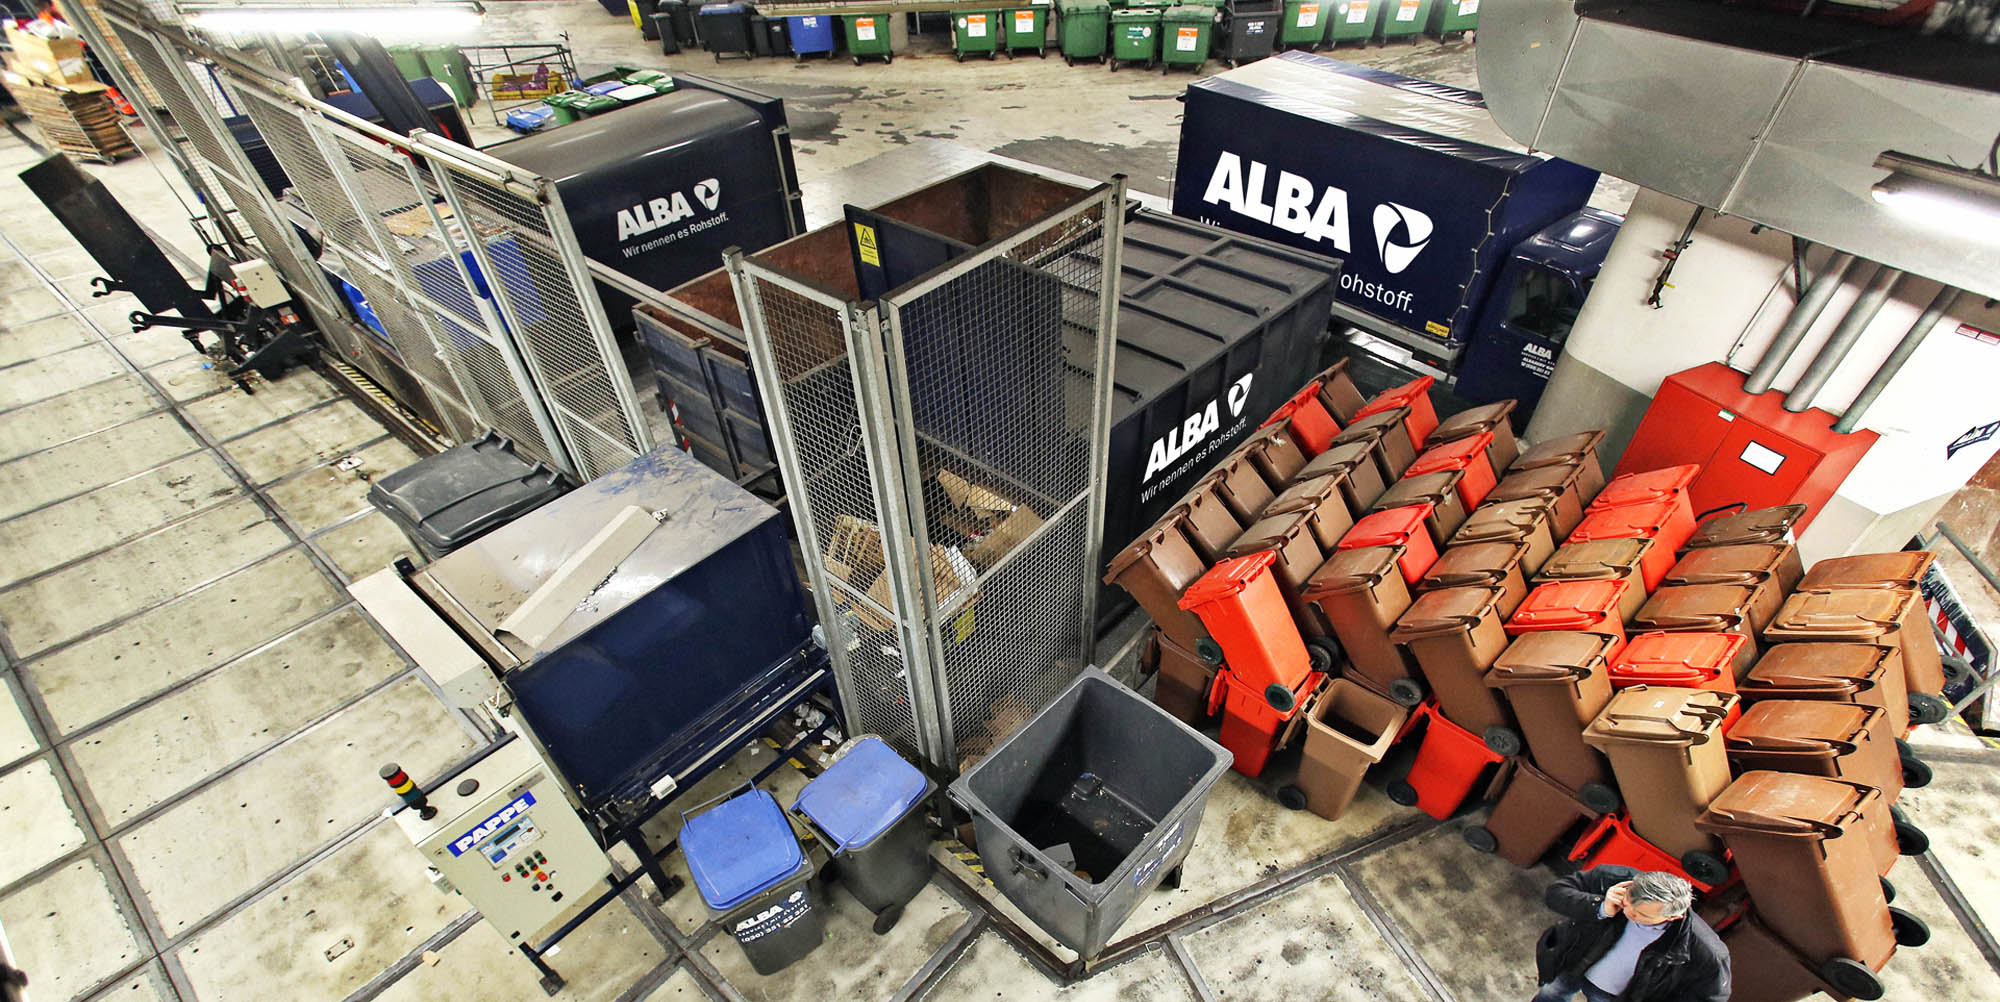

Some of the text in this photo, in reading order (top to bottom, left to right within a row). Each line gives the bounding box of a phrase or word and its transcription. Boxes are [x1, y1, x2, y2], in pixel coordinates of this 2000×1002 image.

[617, 191, 695, 242] ALBA
[1203, 150, 1351, 253] ALBA
[622, 211, 729, 258] Wir nennen es Rohstoff.
[1340, 273, 1413, 314] ohstoff.
[1523, 343, 1552, 360] ALBA
[1141, 416, 1247, 504] Wir nennen es Rohstoff.
[1142, 399, 1220, 484] ALBA
[455, 798, 529, 852] PAPPE
[736, 905, 784, 932] ALBA
